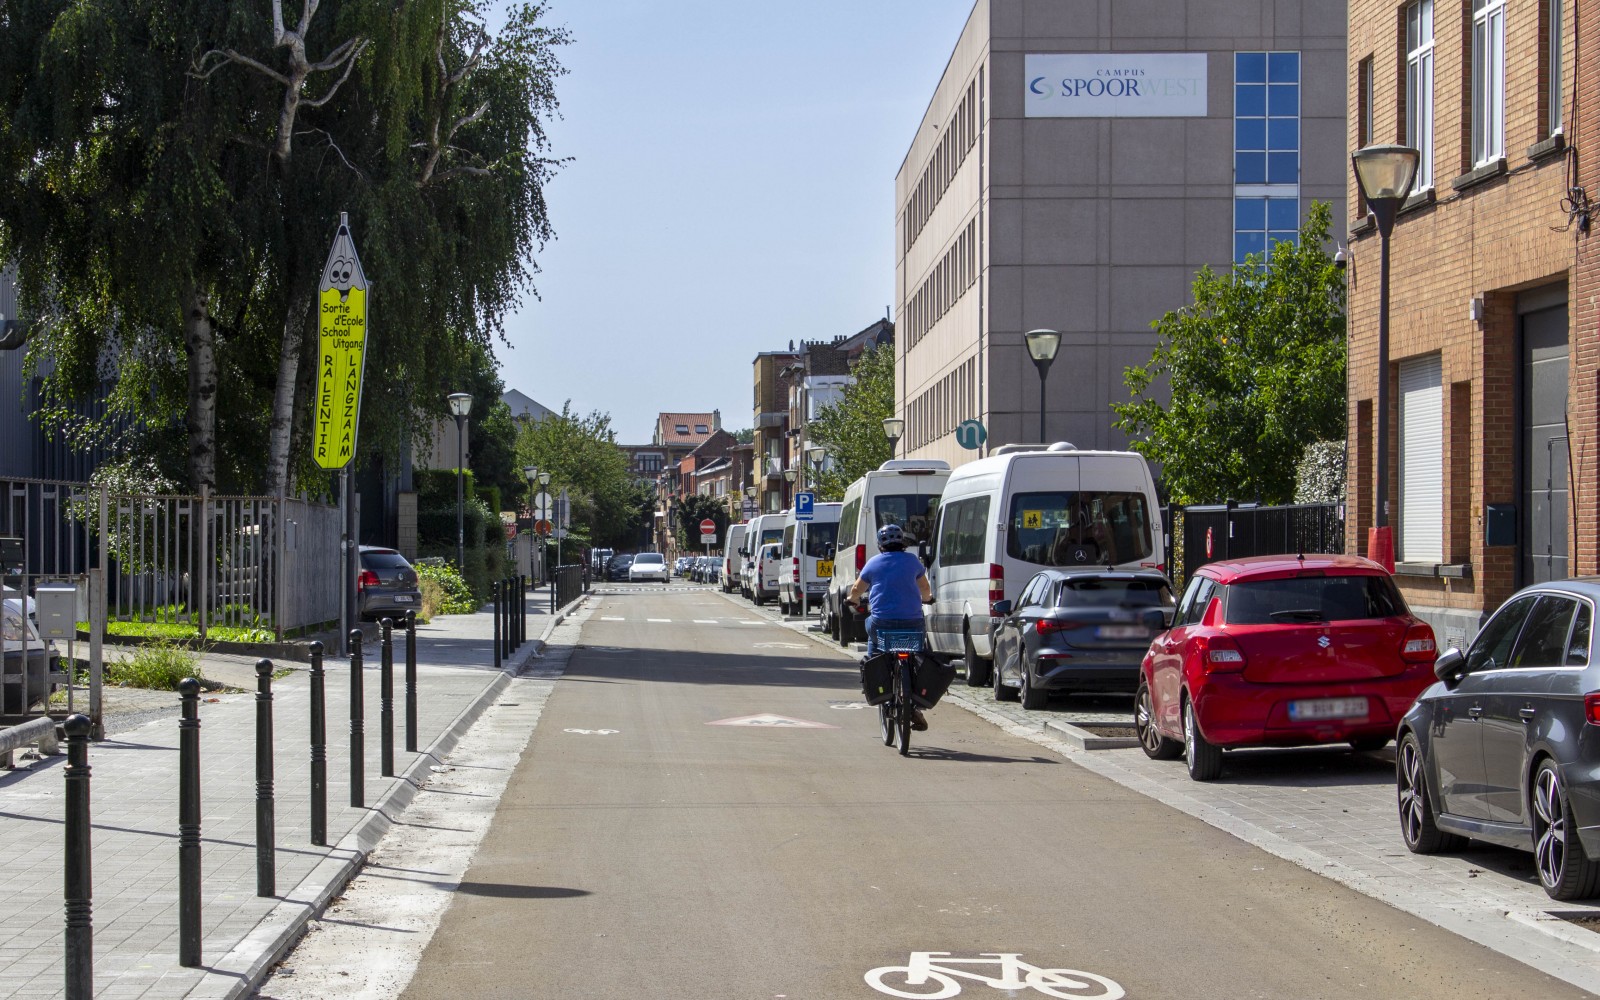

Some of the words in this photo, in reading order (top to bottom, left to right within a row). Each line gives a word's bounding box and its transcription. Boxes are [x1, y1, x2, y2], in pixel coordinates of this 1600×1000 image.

[1061, 78, 1202, 97] SPOORWEST
[322, 303, 350, 313] Sortie
[334, 315, 364, 326] d'Ecole
[321, 326, 350, 337] School
[333, 338, 363, 351] Uitgang
[318, 355, 333, 458] RALENTIR
[339, 355, 357, 457] LANGZAAM
[799, 495, 810, 510] P
